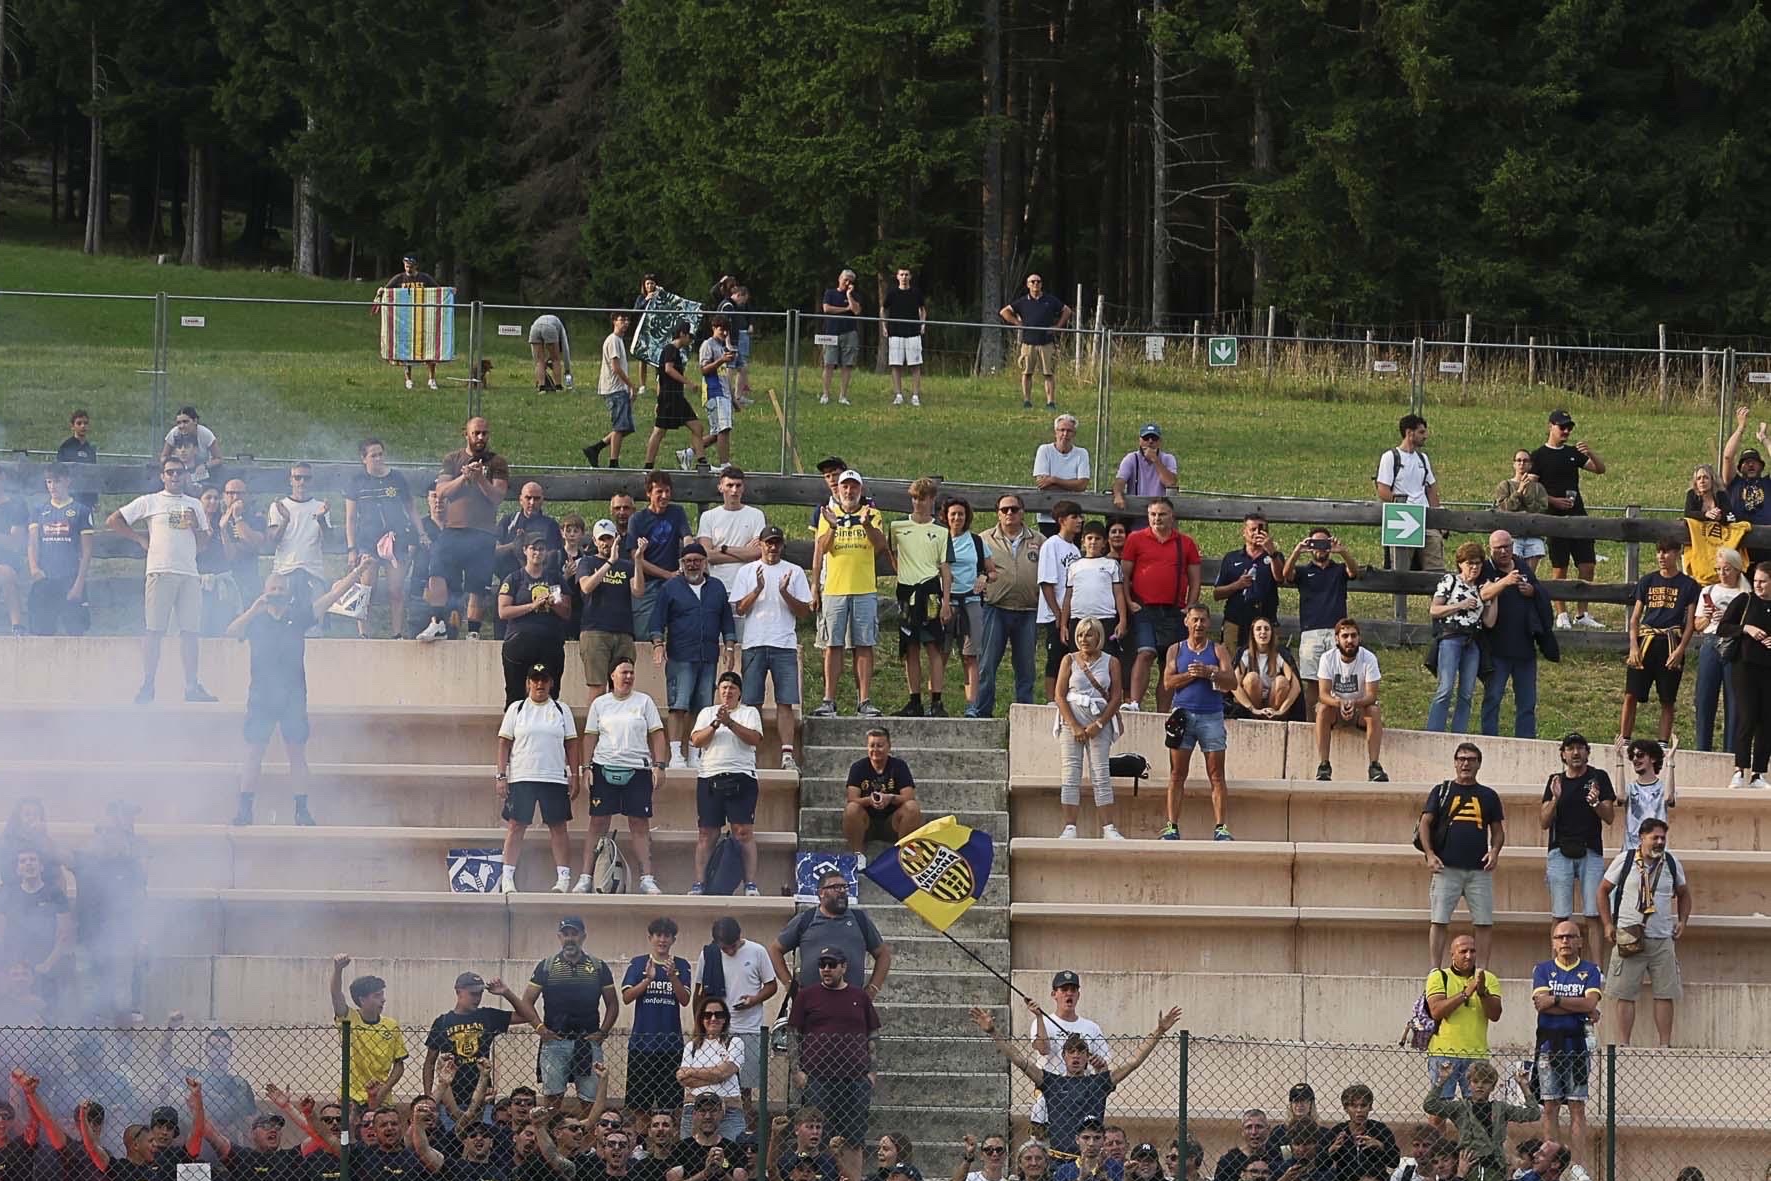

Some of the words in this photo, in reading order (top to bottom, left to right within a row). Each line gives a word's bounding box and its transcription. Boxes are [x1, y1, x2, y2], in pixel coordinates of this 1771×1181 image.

[916, 849, 947, 884] HELLAS
[920, 853, 959, 890] VERONA
[1548, 980, 1585, 996] Sinergy
